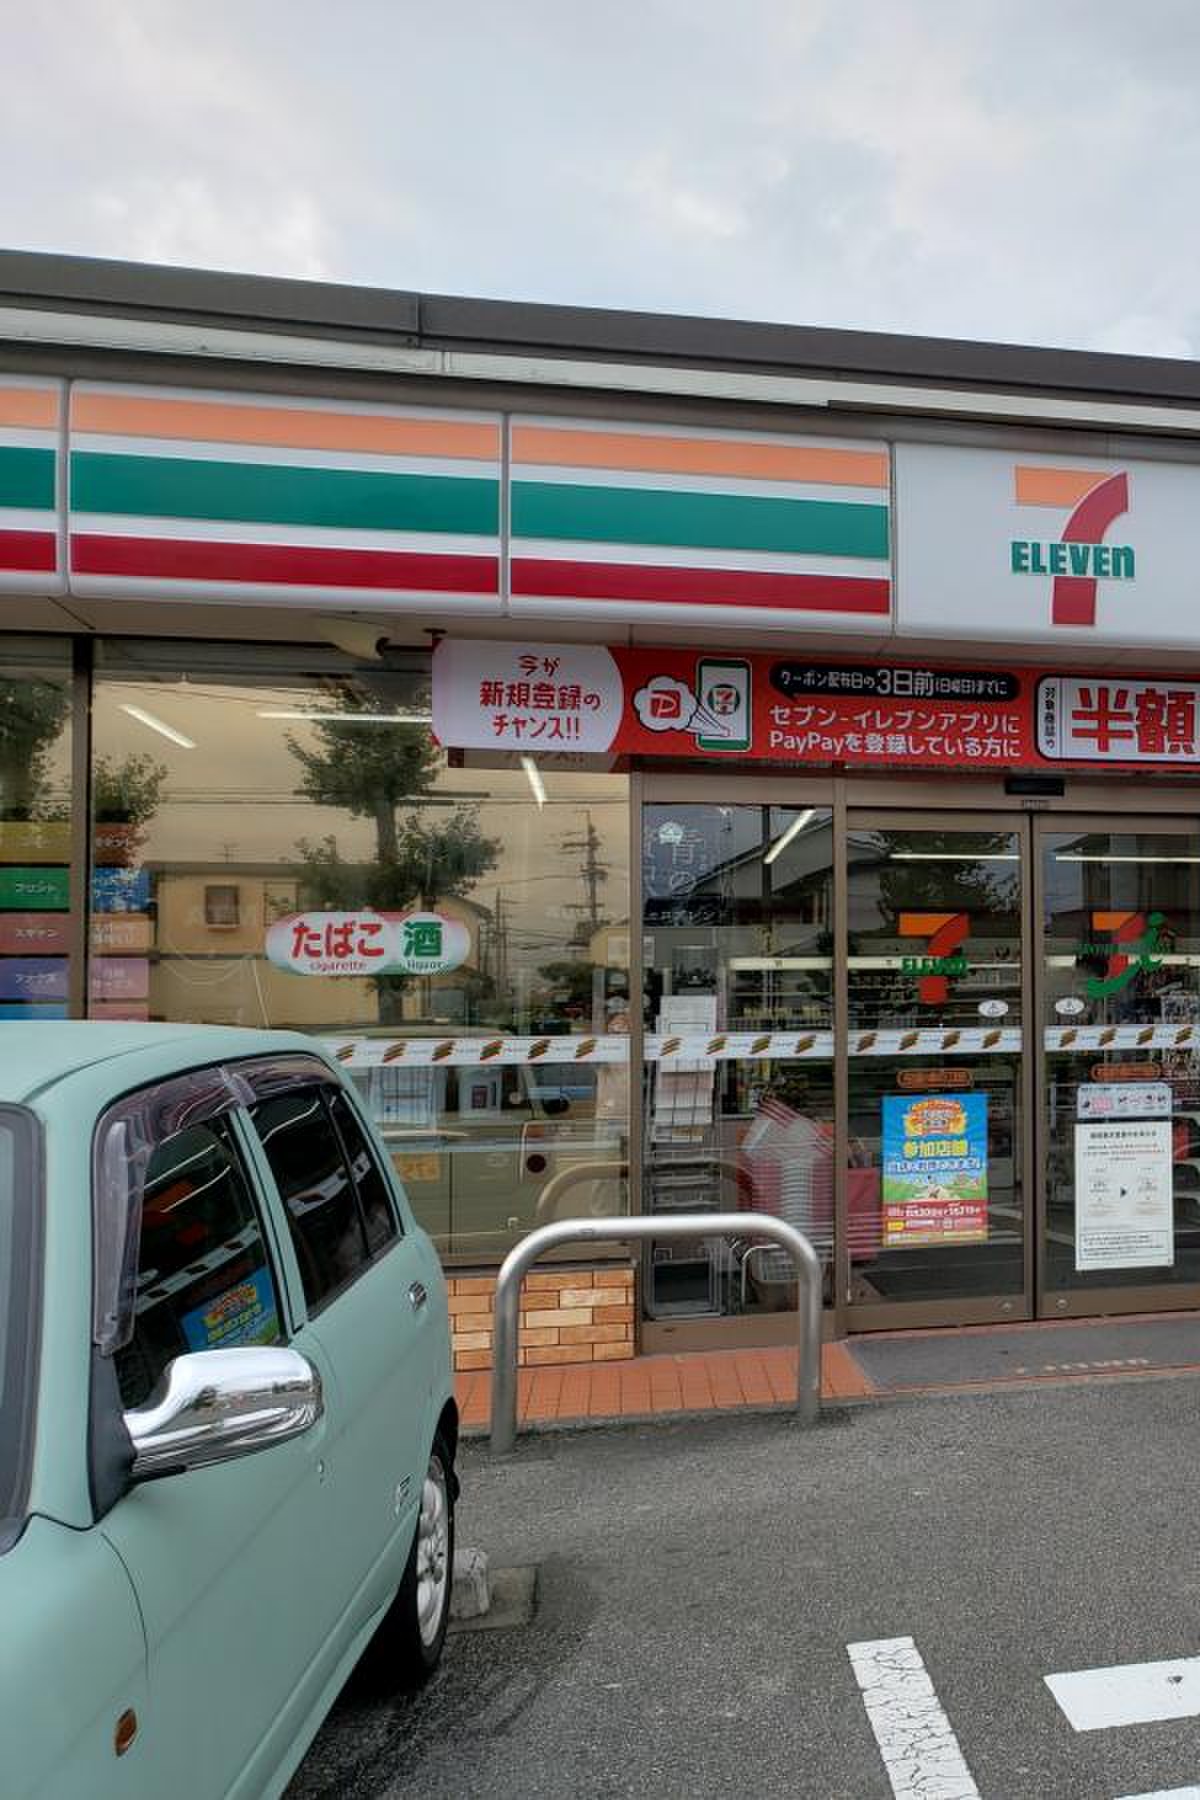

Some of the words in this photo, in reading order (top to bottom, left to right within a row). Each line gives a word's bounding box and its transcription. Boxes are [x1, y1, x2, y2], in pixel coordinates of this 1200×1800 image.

[518, 655, 561, 677] 今が
[479, 681, 601, 711] 新規登録の
[1071, 686, 1197, 755] 半額
[769, 729, 1022, 759] PayPayを登録している方に
[291, 920, 385, 958] たばこ
[403, 920, 443, 957] 酒
